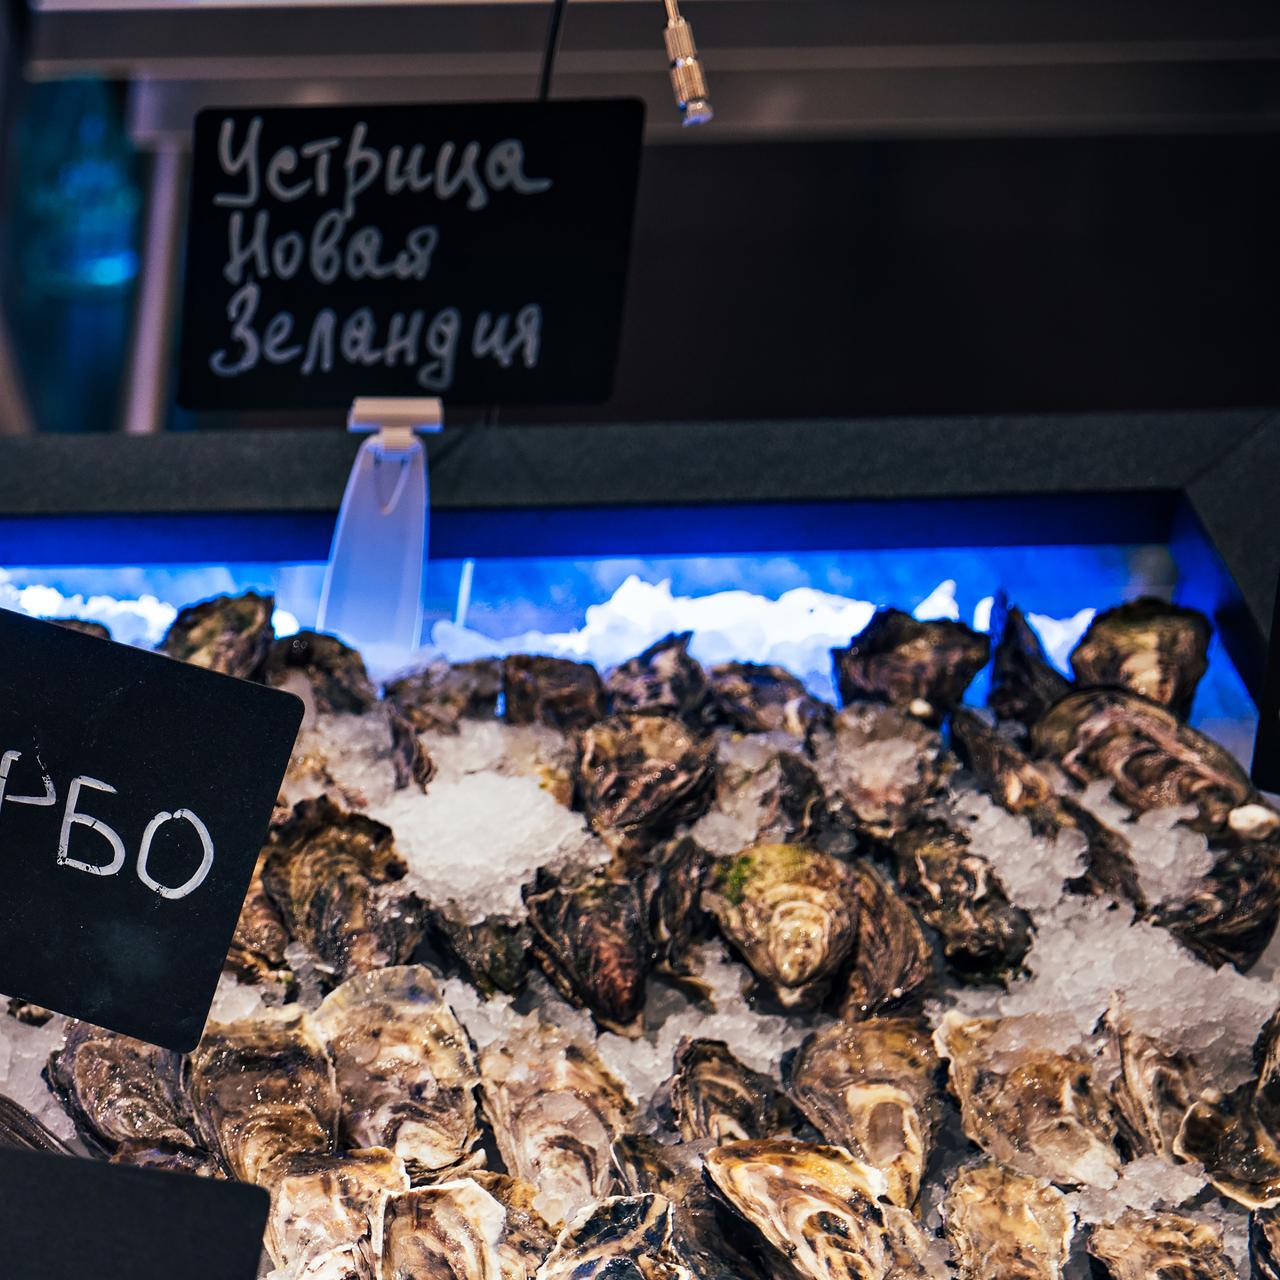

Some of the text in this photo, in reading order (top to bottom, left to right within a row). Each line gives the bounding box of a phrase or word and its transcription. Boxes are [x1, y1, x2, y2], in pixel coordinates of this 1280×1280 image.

[214, 117, 552, 220] Устрица
[223, 208, 438, 283] Новая
[209, 278, 541, 389] Зеландия
